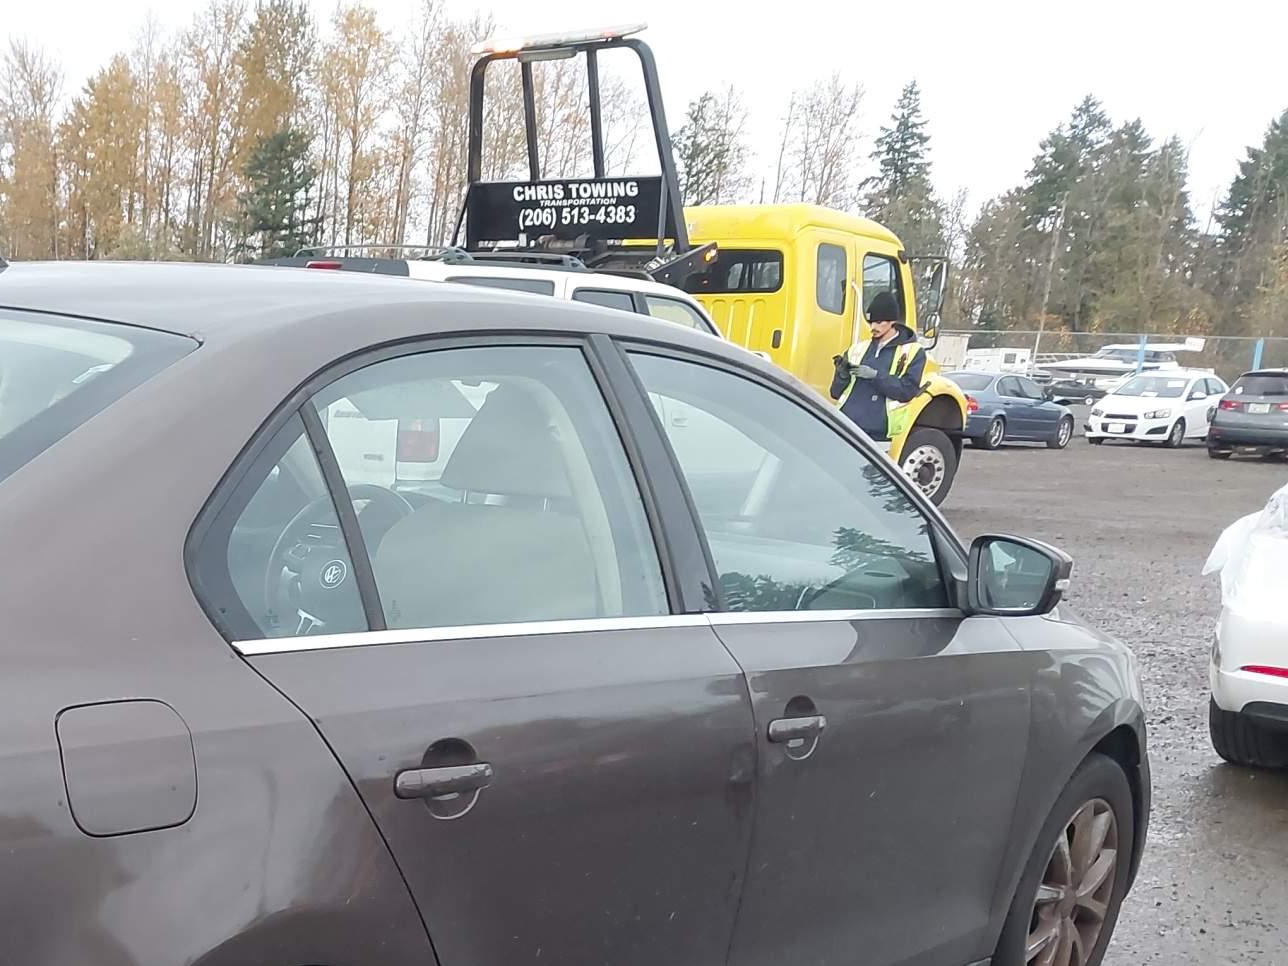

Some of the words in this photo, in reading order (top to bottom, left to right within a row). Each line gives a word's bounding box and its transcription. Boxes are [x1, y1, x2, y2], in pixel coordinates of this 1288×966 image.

[513, 184, 565, 201] CHRIS
[568, 181, 639, 199] TOWING
[540, 198, 617, 206] TRANSPORTATION
[518, 208, 557, 229] (206)
[561, 205, 636, 225] 513-4383
